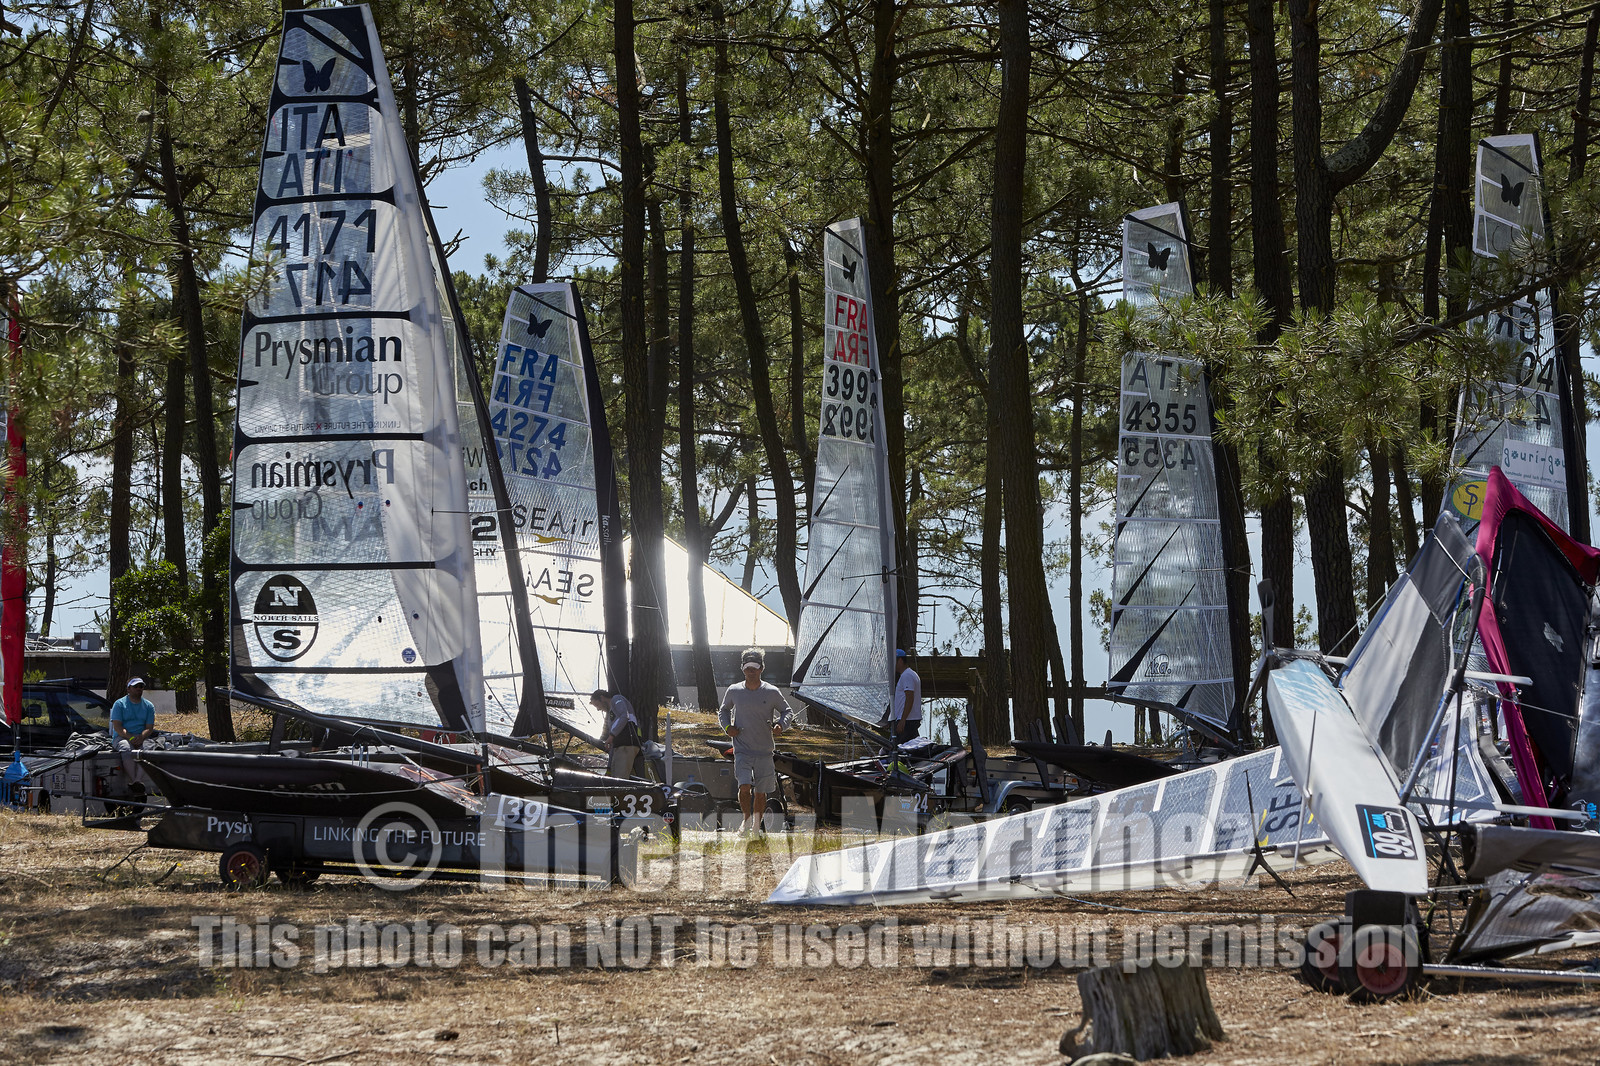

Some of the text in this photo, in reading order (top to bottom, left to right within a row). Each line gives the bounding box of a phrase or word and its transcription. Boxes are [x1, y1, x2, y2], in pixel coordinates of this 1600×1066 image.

[281, 104, 346, 151] ITA
[267, 209, 377, 258] 4171
[834, 295, 868, 334] FRA
[254, 326, 402, 379] Prysmian
[501, 344, 559, 383] FRA
[315, 367, 403, 404] Group
[491, 408, 567, 451] 4274
[1126, 401, 1197, 433] 4355
[269, 587, 302, 607] N
[273, 630, 301, 650] S
[507, 800, 541, 826] 39
[621, 794, 653, 818] 33
[914, 793, 929, 813] 24
[314, 826, 487, 847] LINKING THE FUTURE
